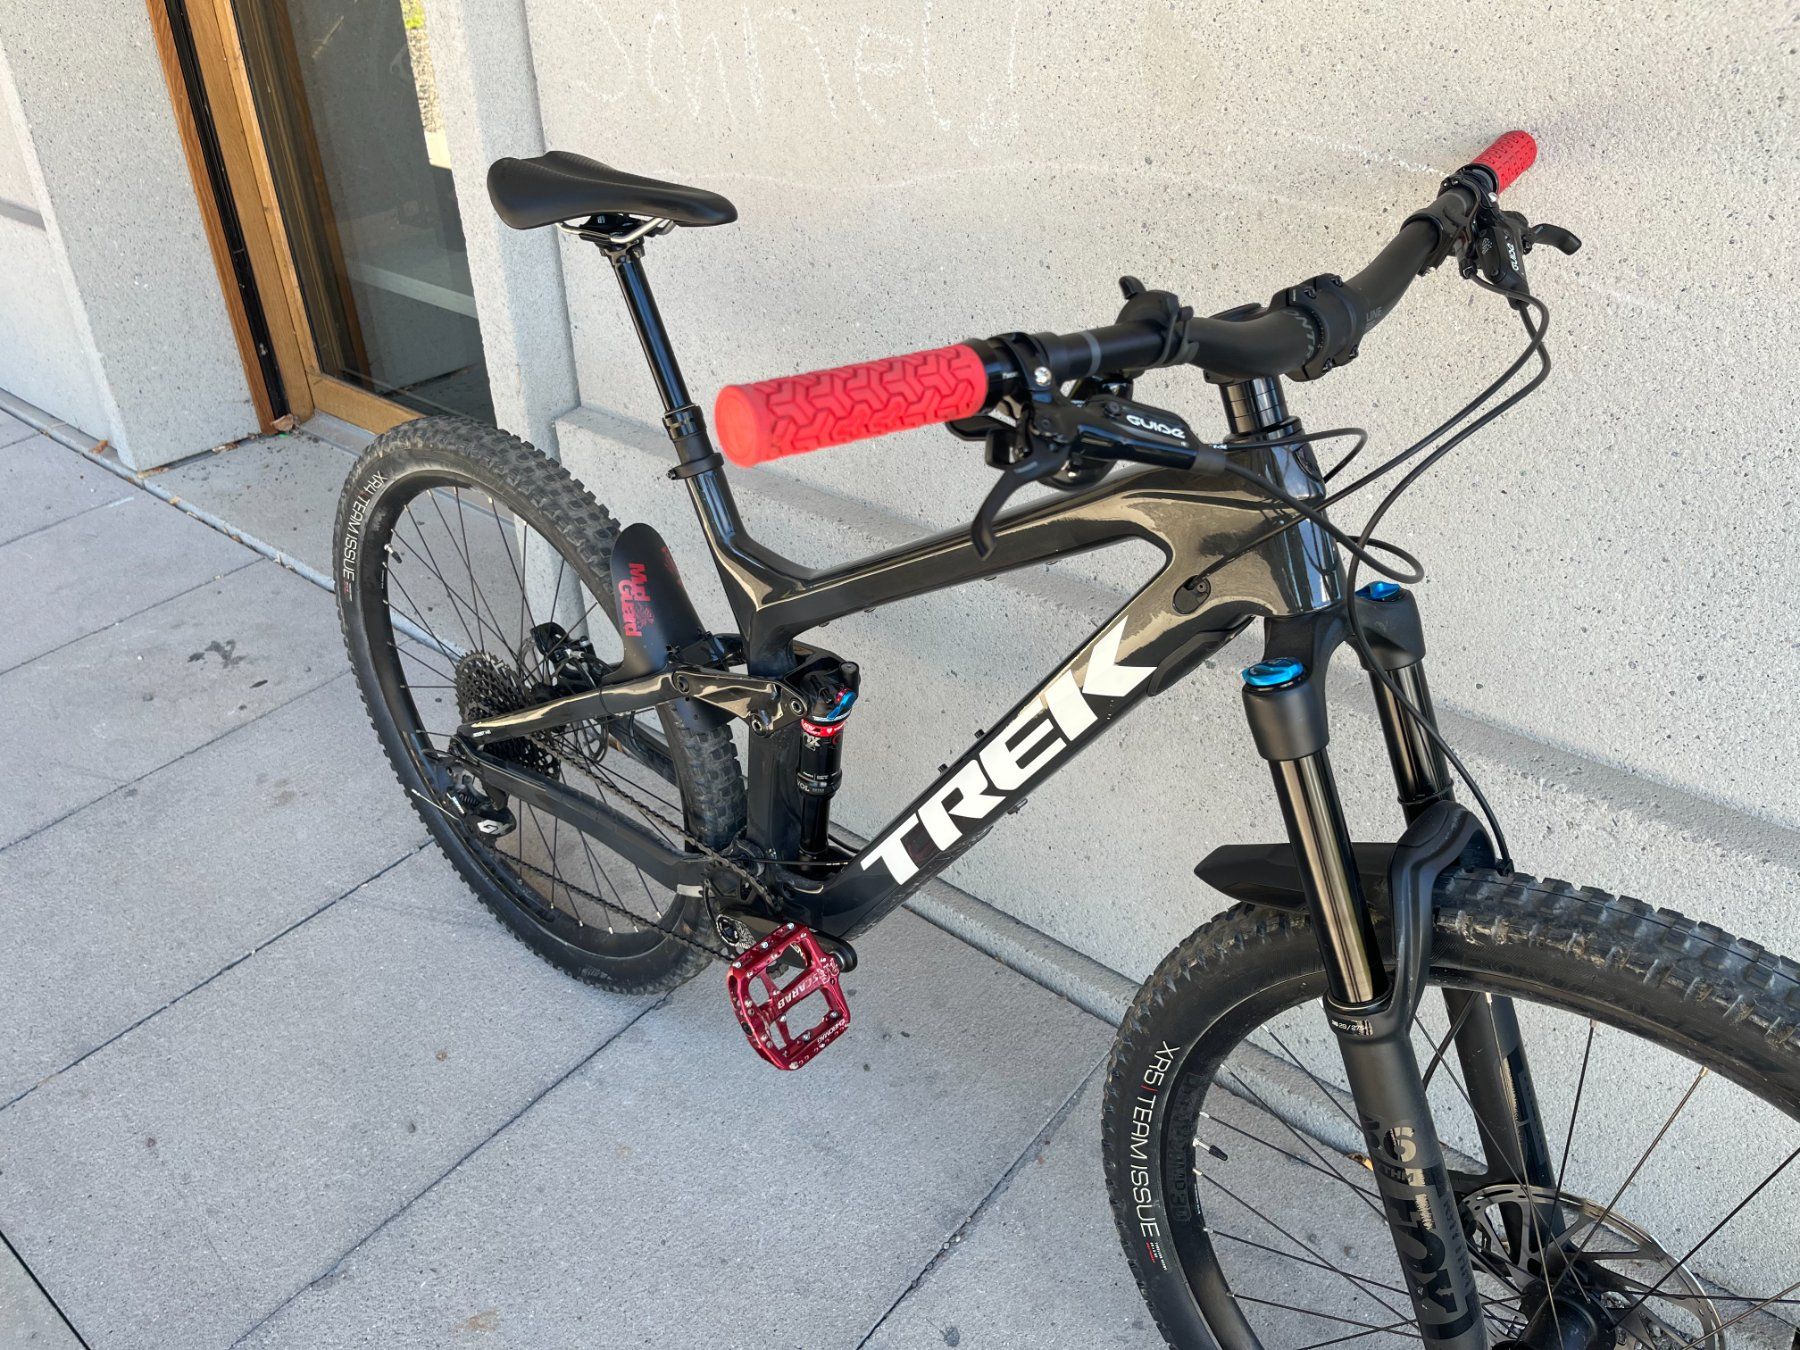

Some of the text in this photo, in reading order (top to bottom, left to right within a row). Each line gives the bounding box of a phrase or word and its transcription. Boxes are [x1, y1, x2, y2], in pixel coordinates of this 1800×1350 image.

[1126, 414, 1186, 439] GUIDE
[363, 470, 388, 495] XR4
[347, 495, 371, 535] TEAM
[342, 534, 359, 581] ISSUE
[861, 616, 1157, 885] TREK
[777, 972, 819, 1010] SCARAB
[1143, 1040, 1180, 1086] XR5
[1130, 1094, 1157, 1161] TEAM
[1130, 1163, 1162, 1238] ISSUE
